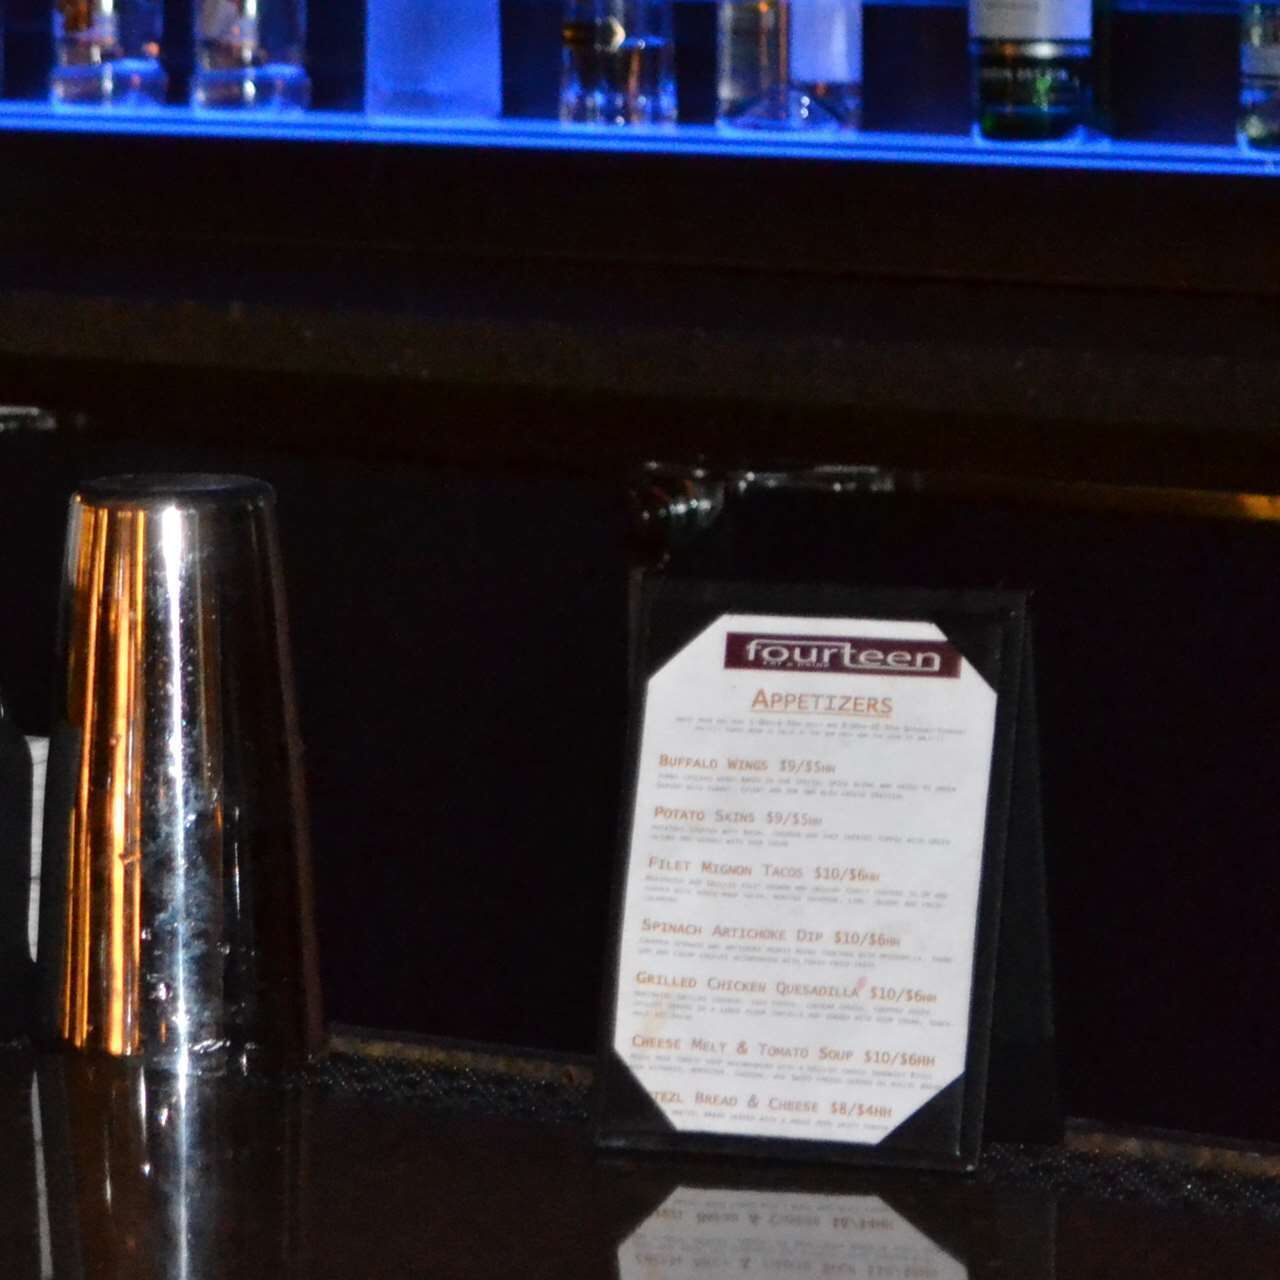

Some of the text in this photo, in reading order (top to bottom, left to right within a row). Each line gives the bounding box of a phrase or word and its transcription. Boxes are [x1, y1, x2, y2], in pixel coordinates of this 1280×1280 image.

[746, 639, 941, 672] fourteen
[751, 688, 894, 714] APPETIZERS
[658, 754, 719, 770] BUFFALO
[727, 758, 769, 772] WINGS
[654, 807, 705, 822] POTATO
[714, 810, 756, 824] SKINS
[648, 856, 692, 873] FILET
[701, 861, 753, 877] MIGNON
[763, 864, 804, 879] TACOS
[641, 918, 702, 936] SPINACH
[712, 924, 787, 941] ARTICHOKE
[796, 927, 824, 942] DIP
[635, 970, 697, 988] GRILLED
[707, 976, 767, 994] CHICKEN
[776, 981, 859, 998] QUESADILLA
[631, 1034, 681, 1051] CHEESE
[691, 1038, 729, 1054] MELT
[736, 1040, 749, 1055] &
[759, 1042, 809, 1058] TOMATO
[818, 1046, 855, 1062] SOUP
[695, 1092, 738, 1107] BREAD
[747, 1094, 759, 1109] &
[768, 1097, 818, 1113] CHEESE
